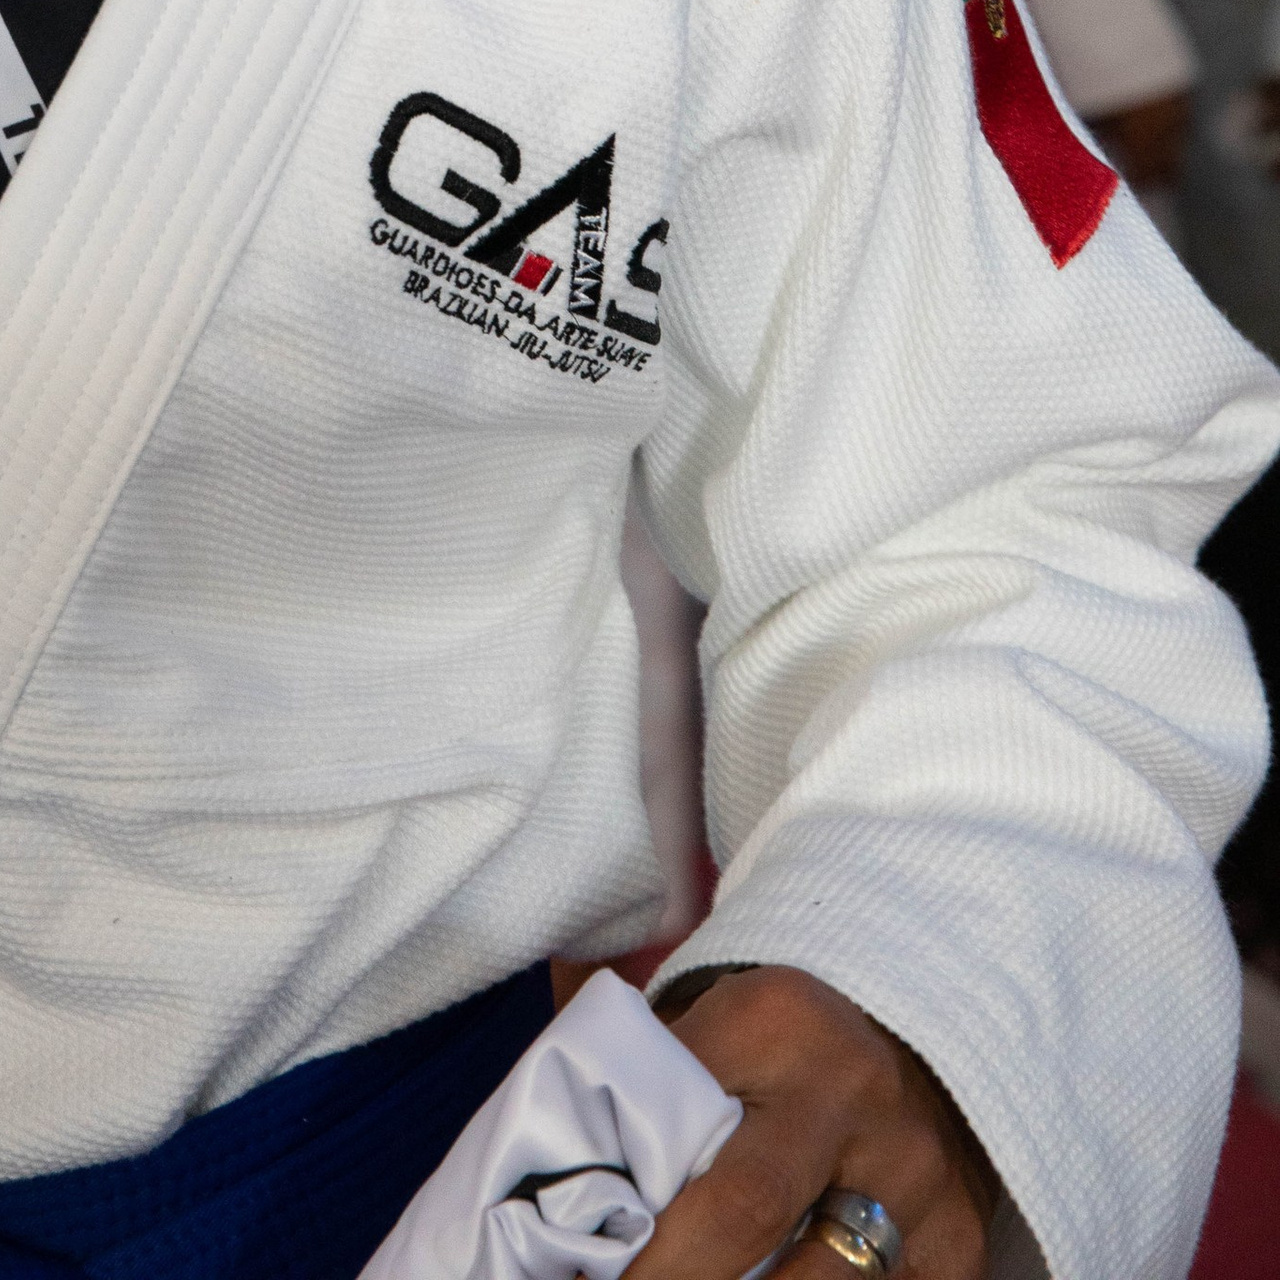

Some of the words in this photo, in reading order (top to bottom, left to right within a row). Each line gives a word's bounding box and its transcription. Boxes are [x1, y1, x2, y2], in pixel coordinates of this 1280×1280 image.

[369, 218, 502, 303] GUARDIOES
[503, 290, 536, 325] DA
[543, 316, 598, 351] ARTE
[596, 335, 652, 372] SUAVE
[403, 270, 510, 337] BRAZILIAN
[568, 206, 608, 312] TEAM
